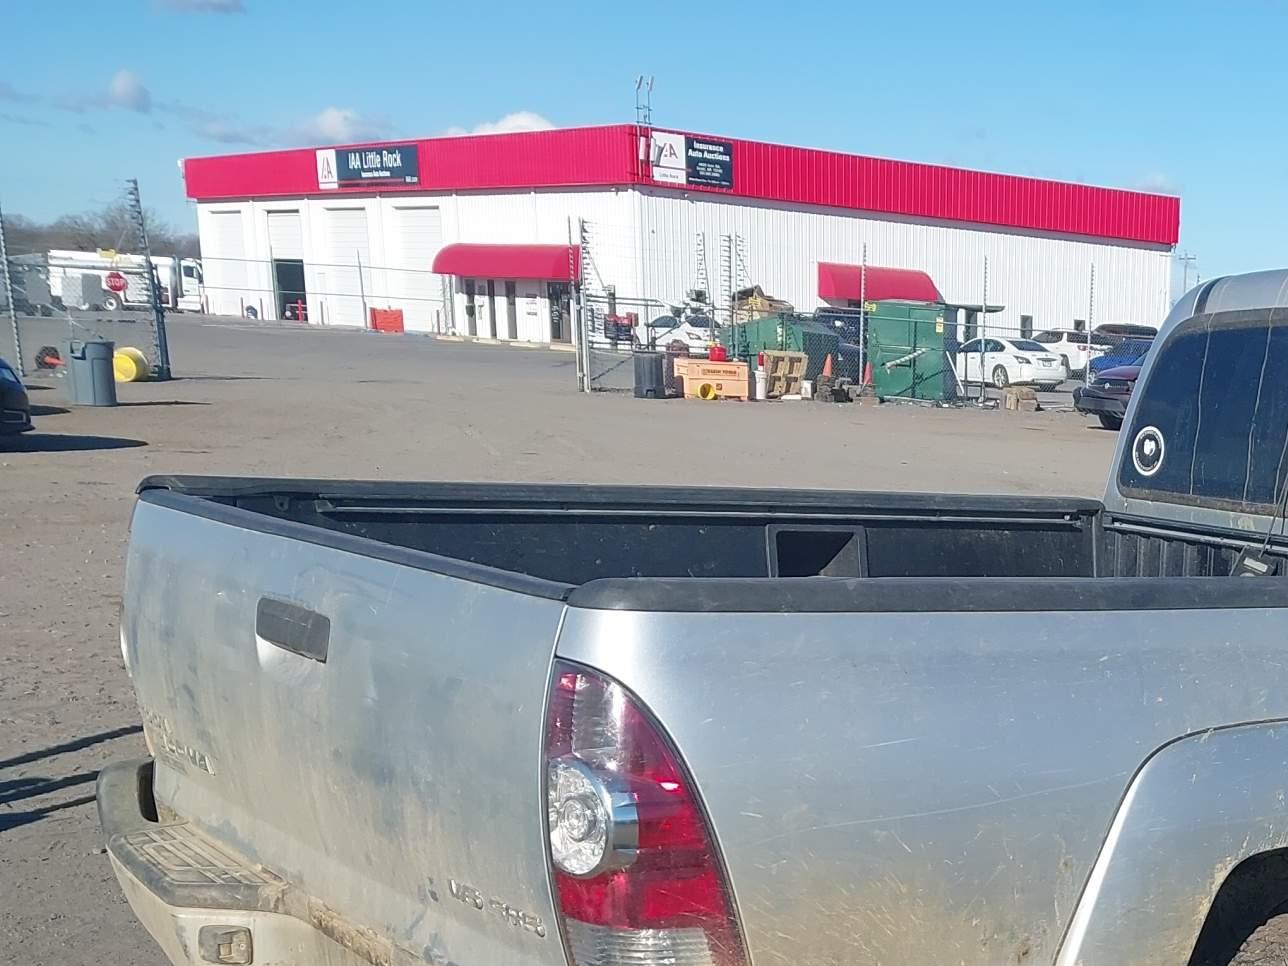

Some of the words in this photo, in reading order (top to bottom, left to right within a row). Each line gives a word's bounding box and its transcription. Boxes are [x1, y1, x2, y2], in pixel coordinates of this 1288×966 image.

[693, 140, 724, 152] Insurance
[348, 152, 361, 169] IAA
[362, 150, 381, 169] Little
[382, 149, 402, 168] Rock
[688, 148, 703, 158] Auto
[703, 151, 730, 162] Auctions
[106, 277, 126, 288] STOP
